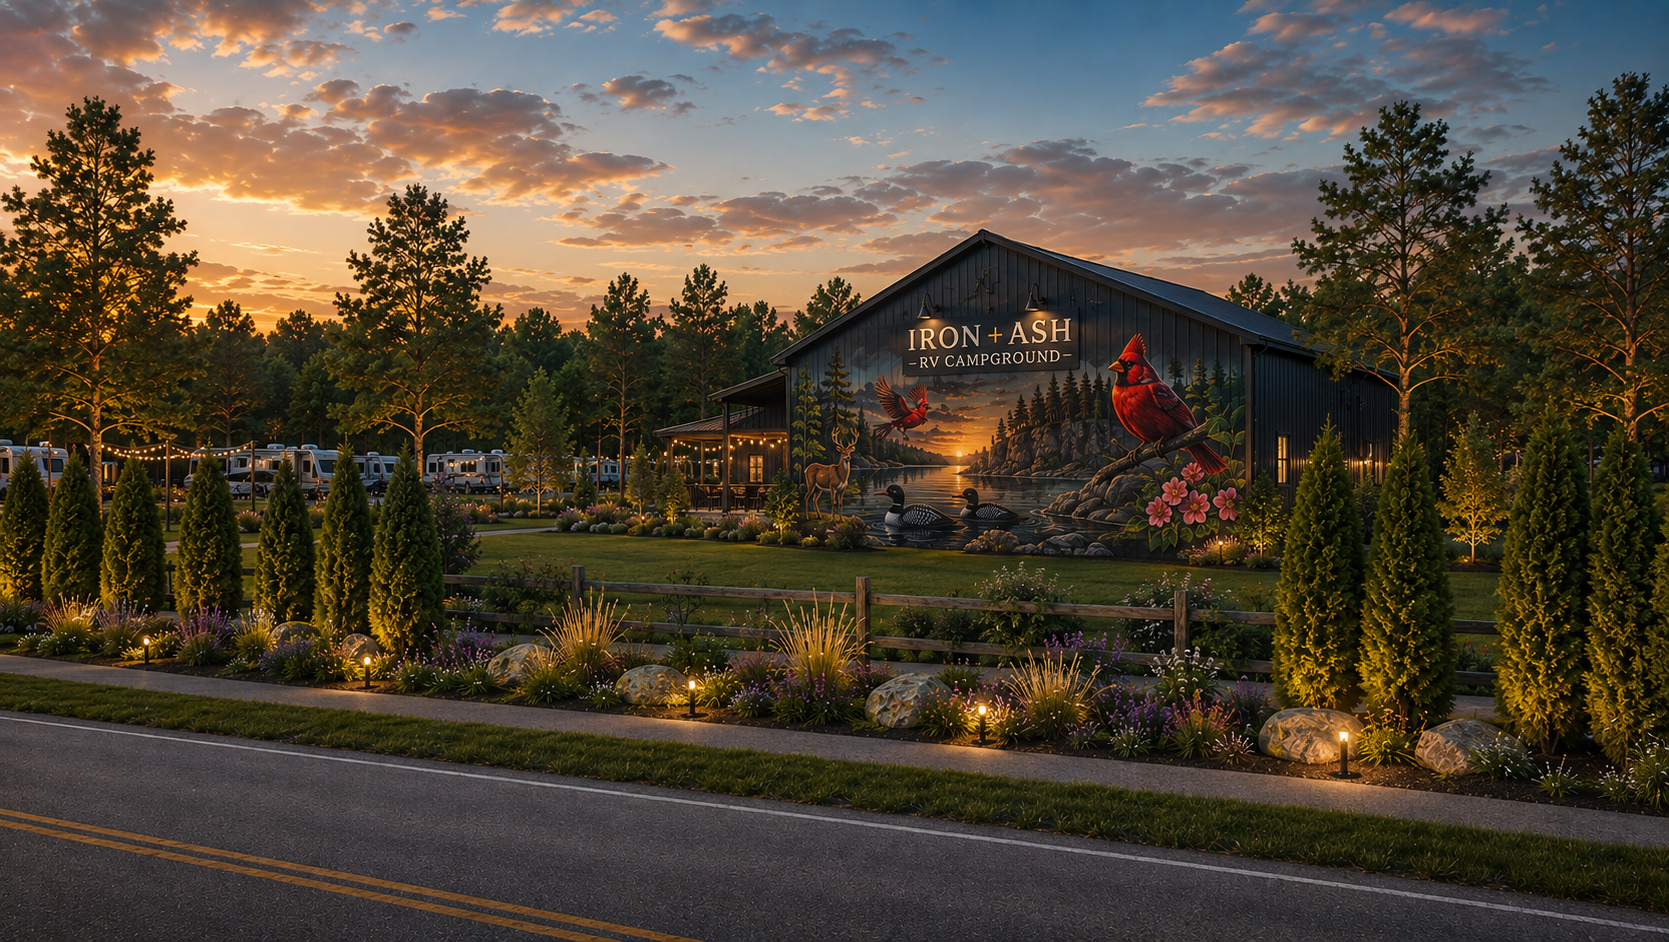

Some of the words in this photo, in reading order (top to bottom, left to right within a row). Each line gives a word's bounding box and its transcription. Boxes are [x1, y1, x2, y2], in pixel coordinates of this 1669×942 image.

[908, 324, 982, 351] IRON
[1008, 318, 1072, 345] ASH
[945, 350, 1061, 368] CAMPGROUND
